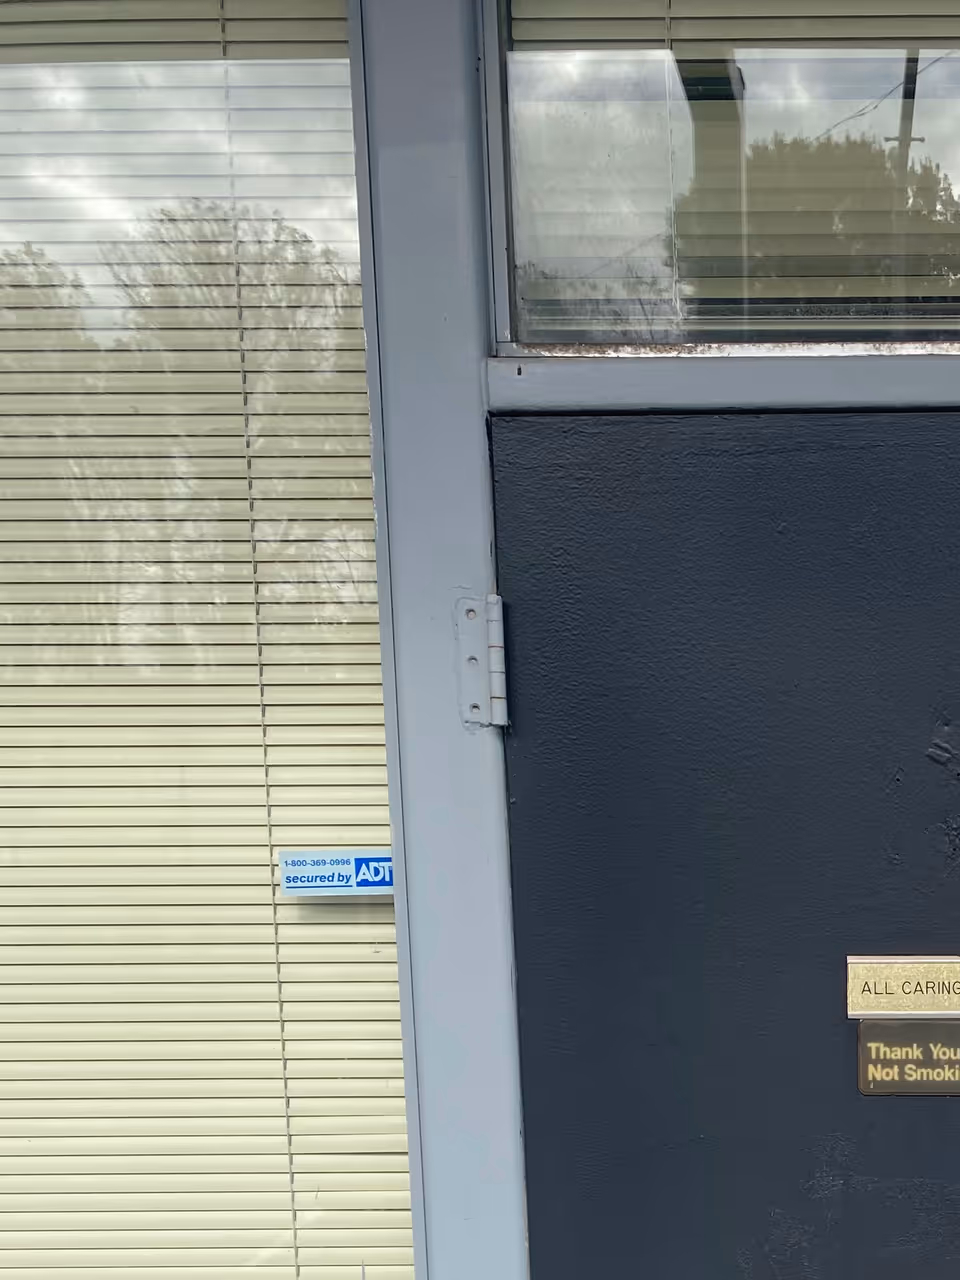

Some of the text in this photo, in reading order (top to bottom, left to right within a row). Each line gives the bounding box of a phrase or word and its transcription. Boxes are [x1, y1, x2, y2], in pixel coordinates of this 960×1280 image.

[284, 859, 351, 867] 1-800-369-0996
[285, 861, 393, 884] secured by ADT
[861, 981, 894, 995] ALL
[867, 1043, 923, 1060] Thank
[929, 1043, 960, 1060] You
[868, 1064, 900, 1081] Not
